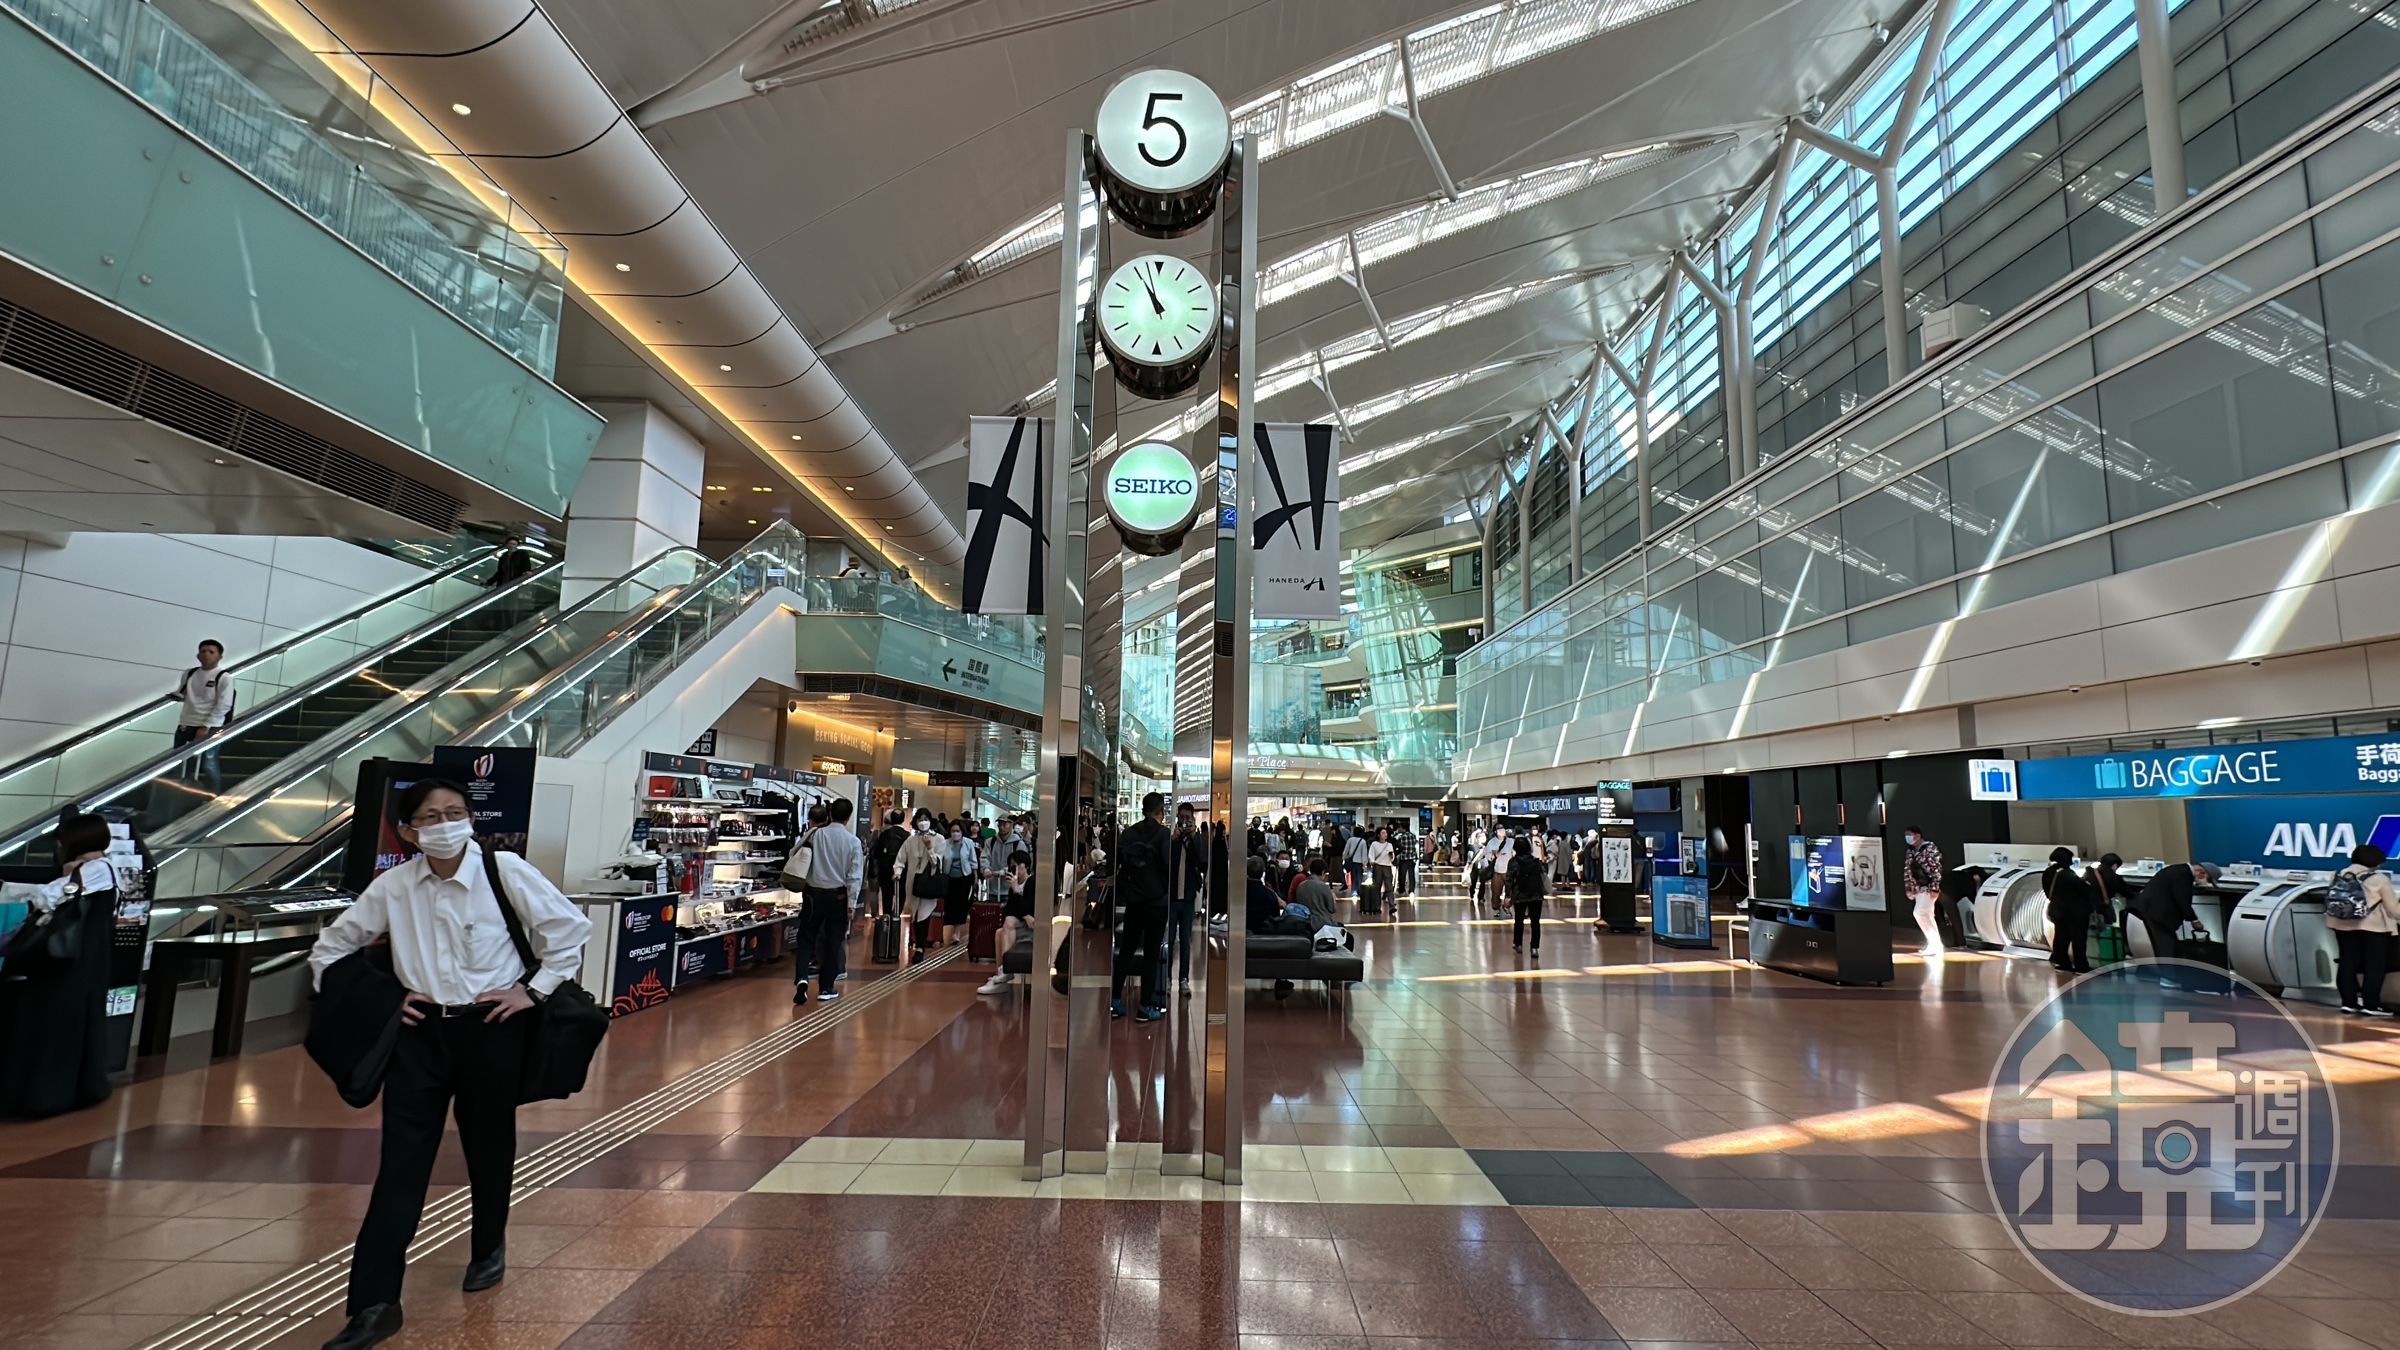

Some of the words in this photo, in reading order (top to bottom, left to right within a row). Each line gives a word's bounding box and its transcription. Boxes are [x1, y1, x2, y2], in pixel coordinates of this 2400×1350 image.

[1137, 92, 1187, 167] 5
[1114, 477, 1193, 496] SEIKO
[1031, 647, 1046, 666] UPP
[815, 730, 838, 744] EEKING
[1257, 755, 1287, 768] Place
[2131, 750, 2281, 789] BAGGAGE
[2358, 767, 2400, 784] Bagg
[1599, 782, 1630, 790] BAGGAGE
[2263, 822, 2356, 858] ANA
[629, 947, 651, 958] OFFICIAL
[651, 943, 667, 953] STORE
